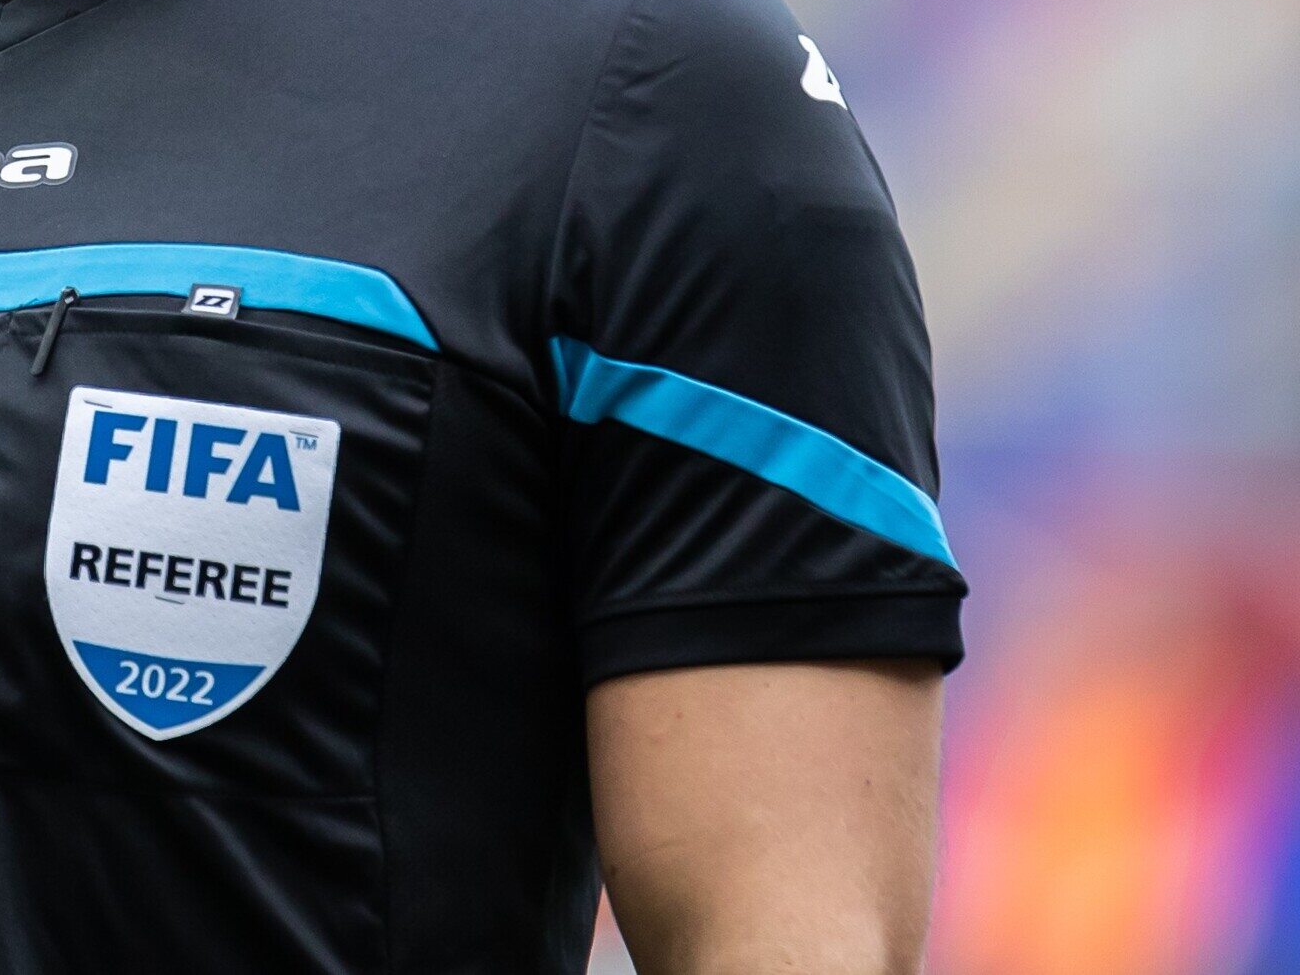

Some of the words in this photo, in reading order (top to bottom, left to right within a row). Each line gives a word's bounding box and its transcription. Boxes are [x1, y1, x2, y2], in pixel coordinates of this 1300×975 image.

[83, 410, 301, 512] FIFA
[69, 541, 293, 608] REFEREE
[115, 659, 216, 707] 2022
